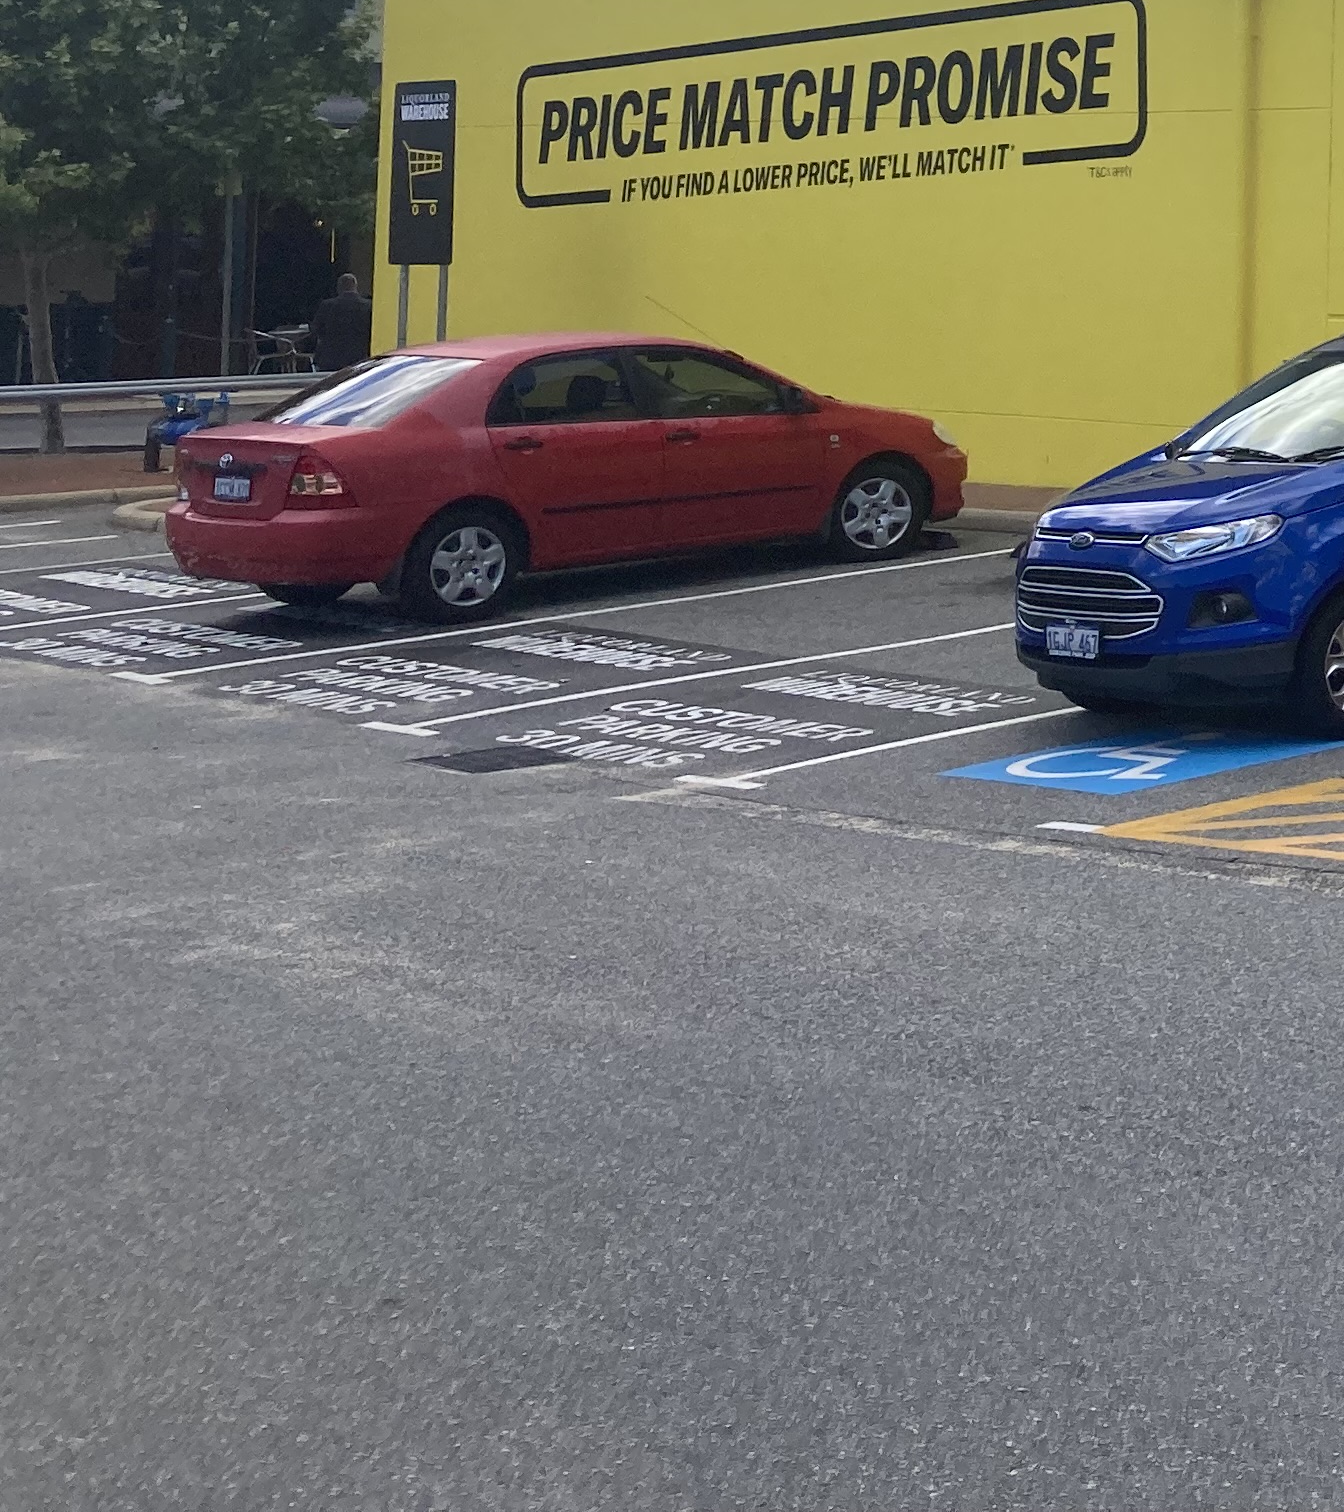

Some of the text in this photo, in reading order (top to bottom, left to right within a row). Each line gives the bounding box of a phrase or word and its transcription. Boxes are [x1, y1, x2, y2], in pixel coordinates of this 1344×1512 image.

[538, 32, 1116, 165] PRICE MATCH PROMISE
[621, 178, 637, 202] IF
[639, 175, 672, 200] YOU
[675, 171, 715, 198] FIND
[717, 169, 729, 194] A
[733, 164, 792, 193] LOWER
[796, 157, 854, 189] PRICE,
[859, 154, 912, 183] WE'LL
[915, 149, 985, 178] MATCH
[280, 668, 474, 702] PARKING
[336, 655, 561, 694] CUSTOMER
[218, 680, 397, 715] 30 MINS
[557, 714, 782, 754] PARKING
[610, 698, 875, 742] CUSTOMER
[495, 728, 706, 768] 30 MINS
